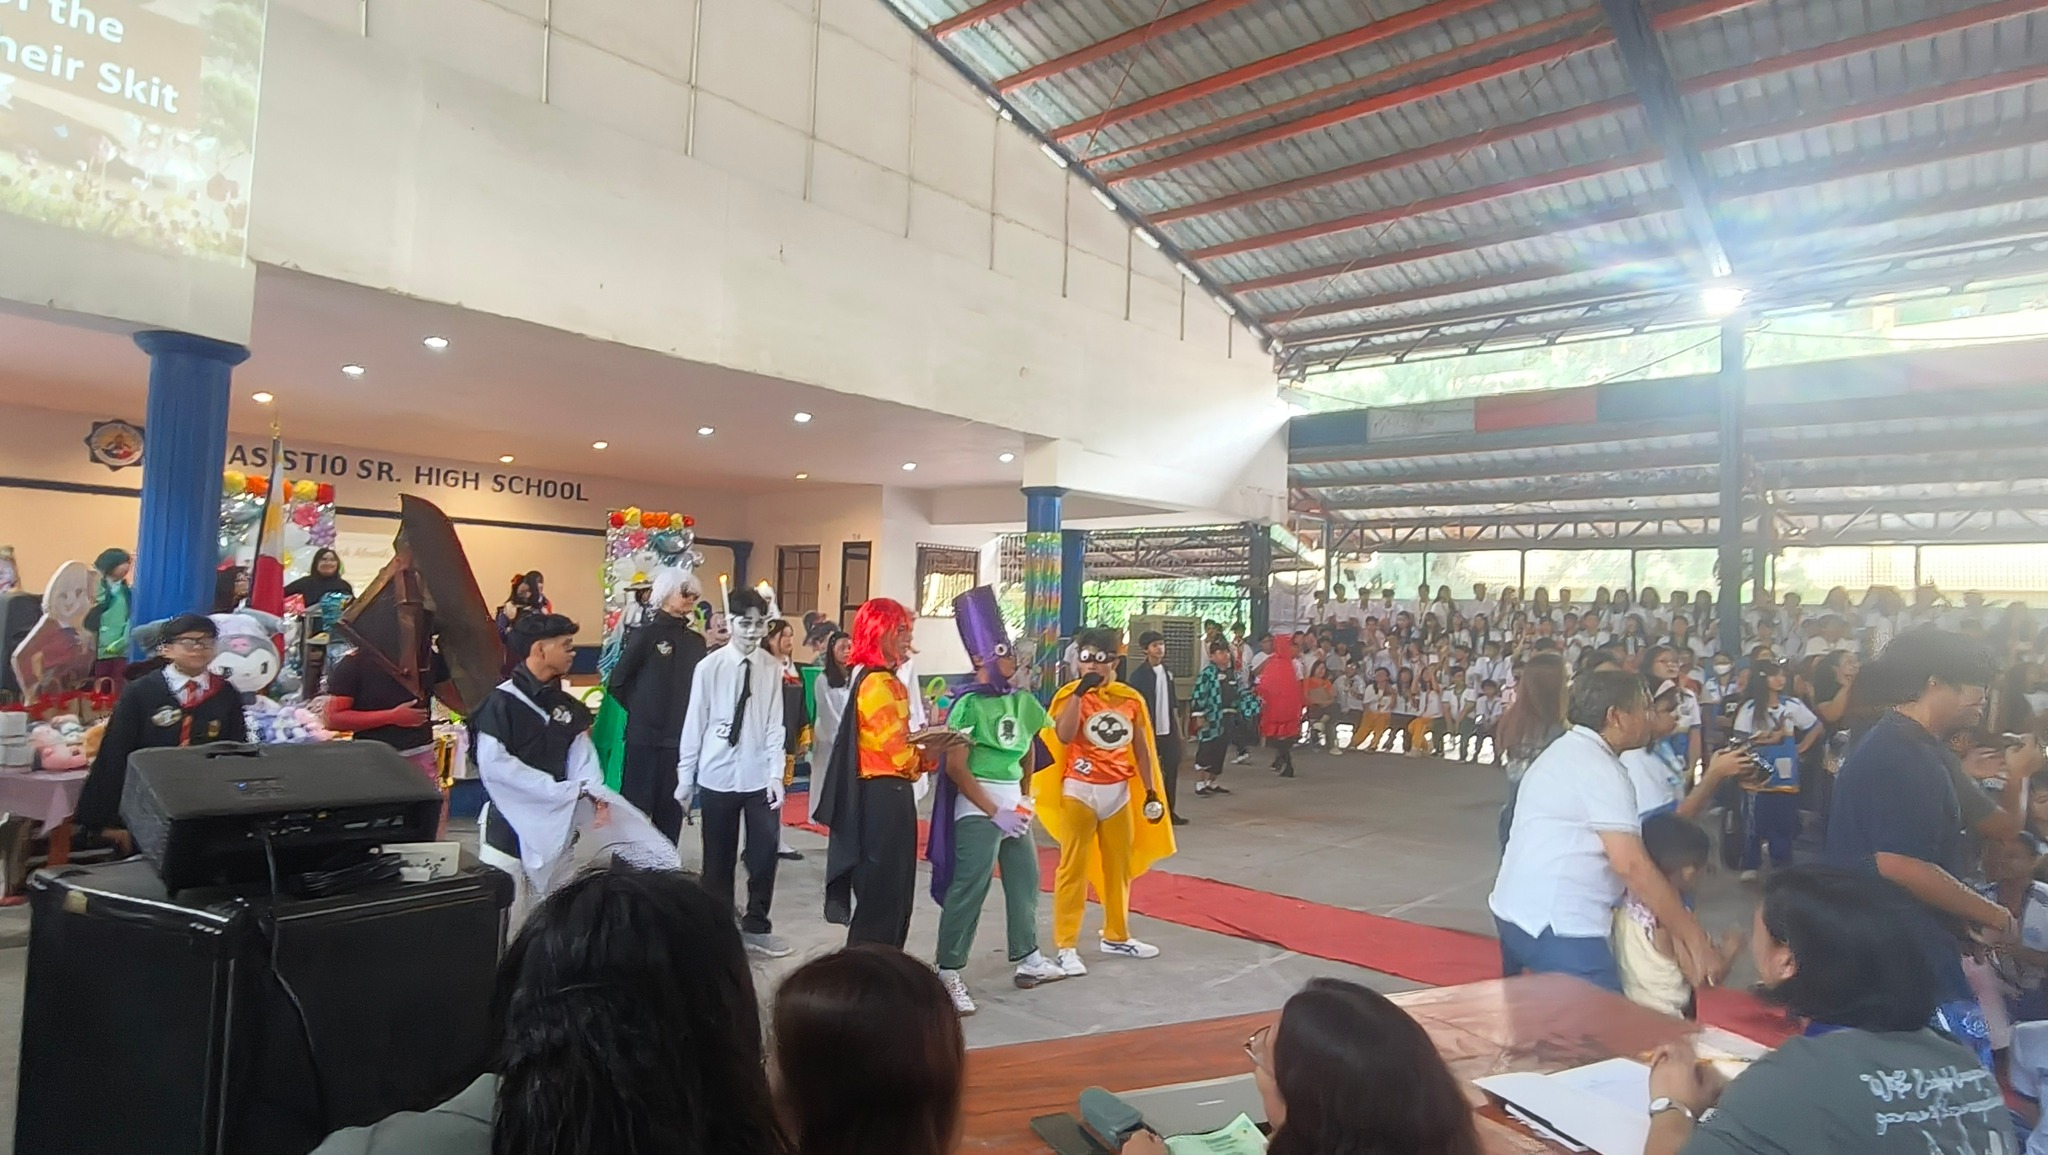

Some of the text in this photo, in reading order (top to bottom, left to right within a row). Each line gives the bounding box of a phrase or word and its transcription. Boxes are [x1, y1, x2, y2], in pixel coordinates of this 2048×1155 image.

[50, 0, 124, 43] the
[97, 62, 179, 114] Skit
[228, 444, 589, 501] ASSTIO SR. HIGH SCHOOL
